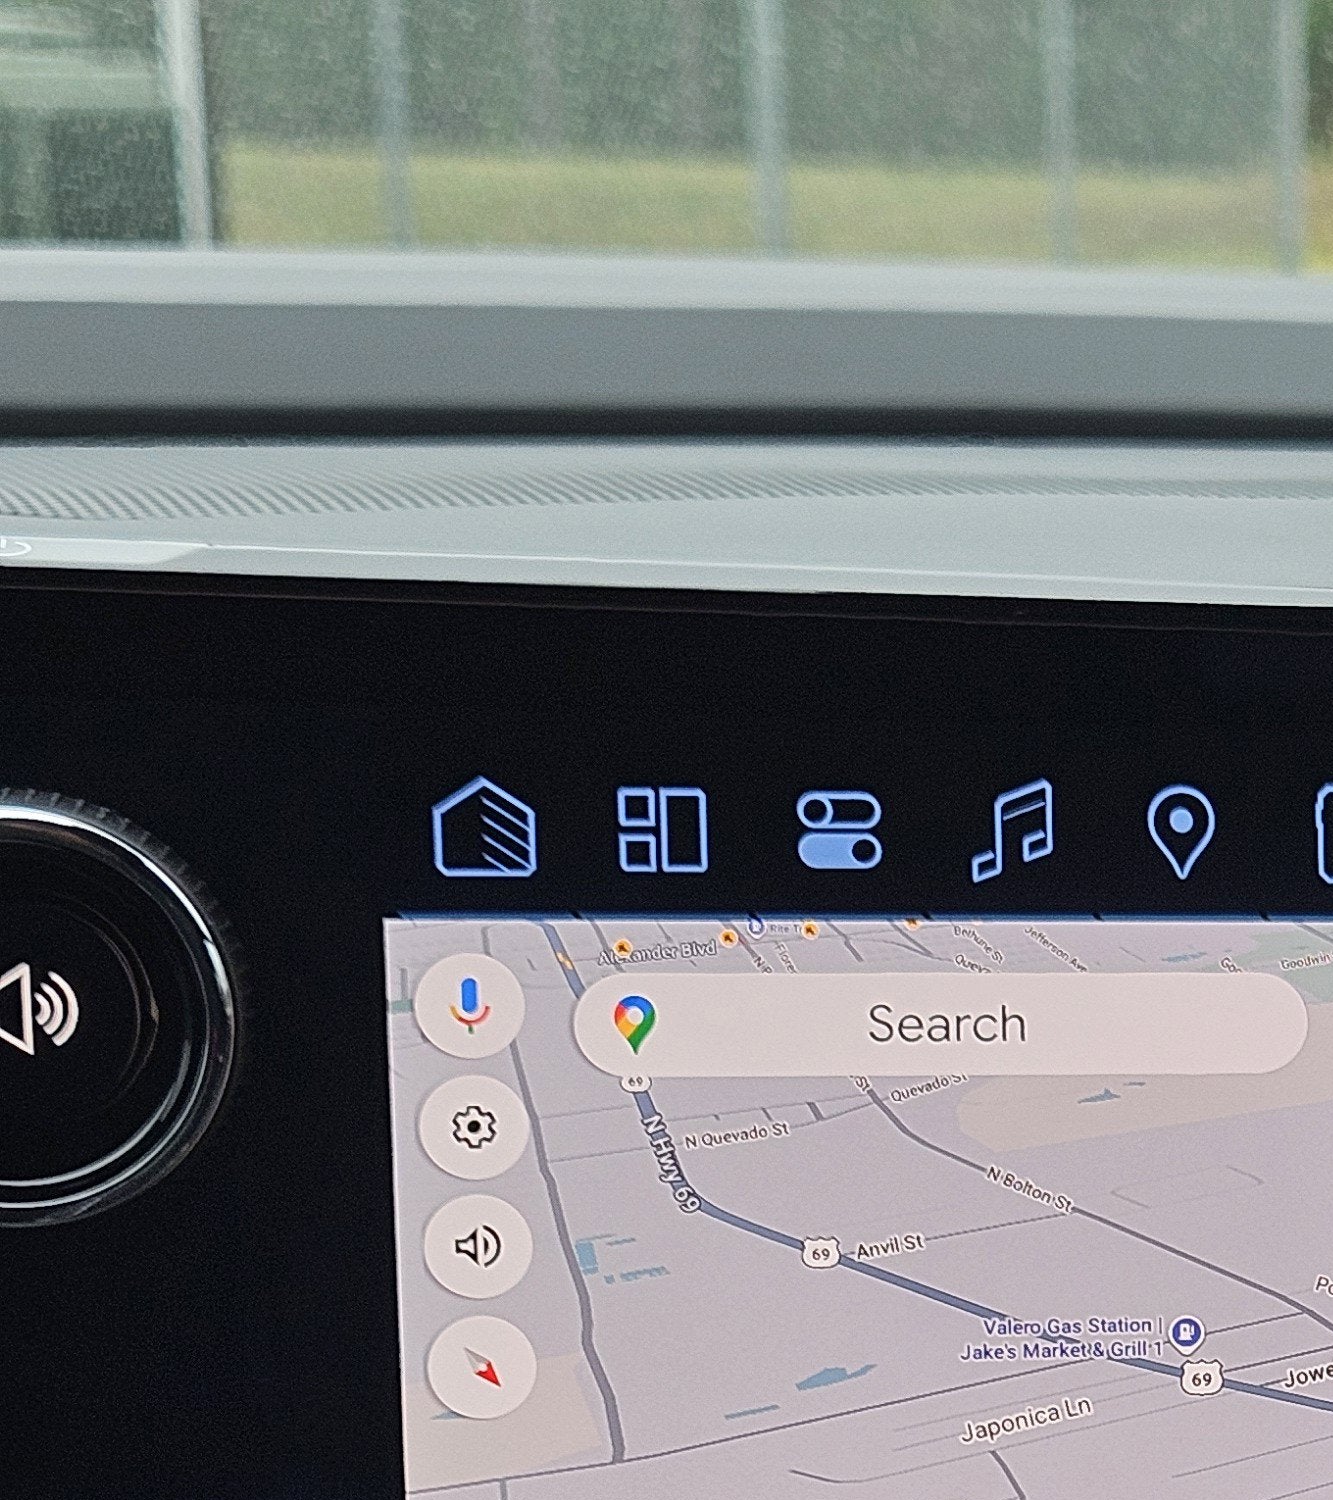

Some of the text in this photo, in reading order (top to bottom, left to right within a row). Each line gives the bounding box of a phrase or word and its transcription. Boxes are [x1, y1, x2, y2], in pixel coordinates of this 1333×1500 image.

[681, 938, 718, 958] Blvd
[1024, 926, 1071, 962] Jefferson
[868, 1003, 1026, 1043] Search
[890, 1076, 950, 1102] Quevado
[685, 1122, 790, 1149] N Quevado St
[641, 1112, 701, 1213] N Hwy 69
[986, 1166, 1072, 1213] N Bolton St
[811, 1247, 831, 1261] 69
[856, 1234, 925, 1260] Anvil St
[983, 1319, 1041, 1336] Valero
[1046, 1318, 1082, 1335] Gas
[1088, 1318, 1152, 1334] Station
[960, 1343, 1017, 1361] Jake's
[1023, 1341, 1088, 1358] Market
[1092, 1342, 1105, 1358] &
[1107, 1340, 1147, 1358] Grill
[1191, 1372, 1213, 1387] 69
[961, 1398, 1092, 1443] Japonica Ln
